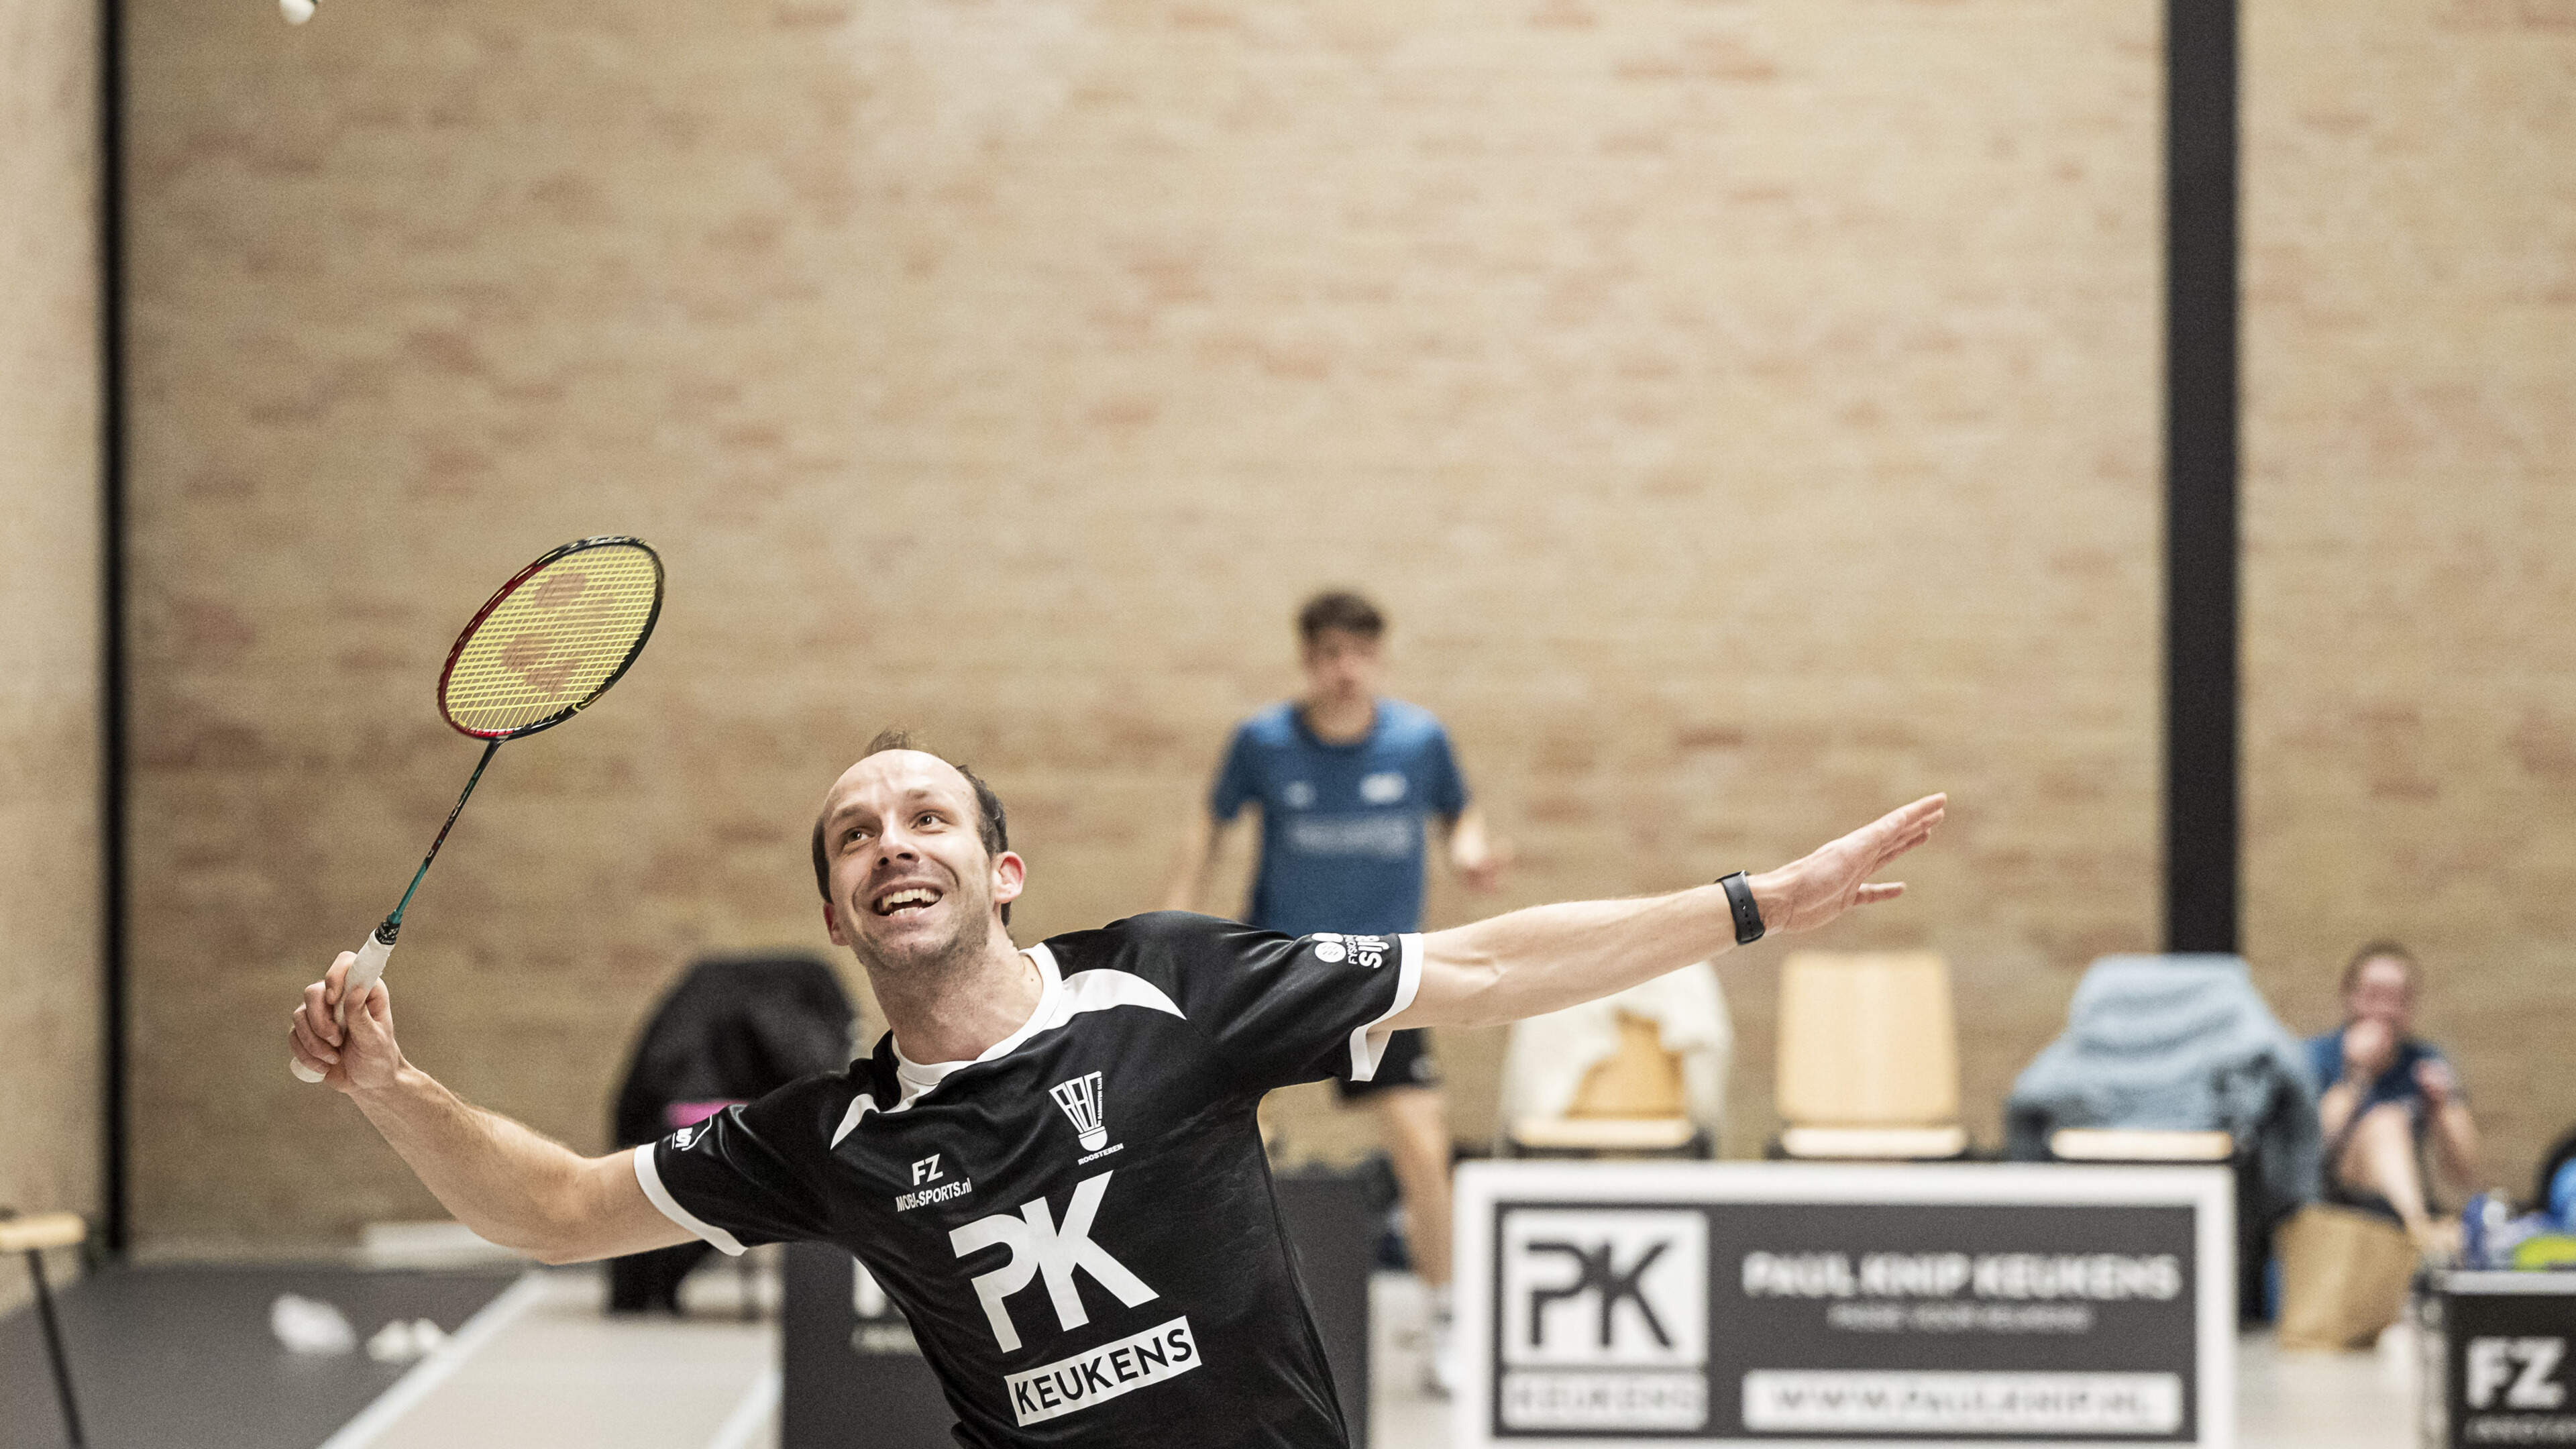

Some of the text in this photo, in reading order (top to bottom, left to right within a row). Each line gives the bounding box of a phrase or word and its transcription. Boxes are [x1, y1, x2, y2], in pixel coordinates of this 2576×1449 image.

[912, 1153, 944, 1186] FZ
[1077, 1143, 1124, 1165] ROOSTEREN
[949, 1169, 1160, 1354] PK
[1525, 1240, 1672, 1348] PK
[1014, 1328, 1193, 1415] KEUKENS
[2467, 1337, 2567, 1408] FZ
